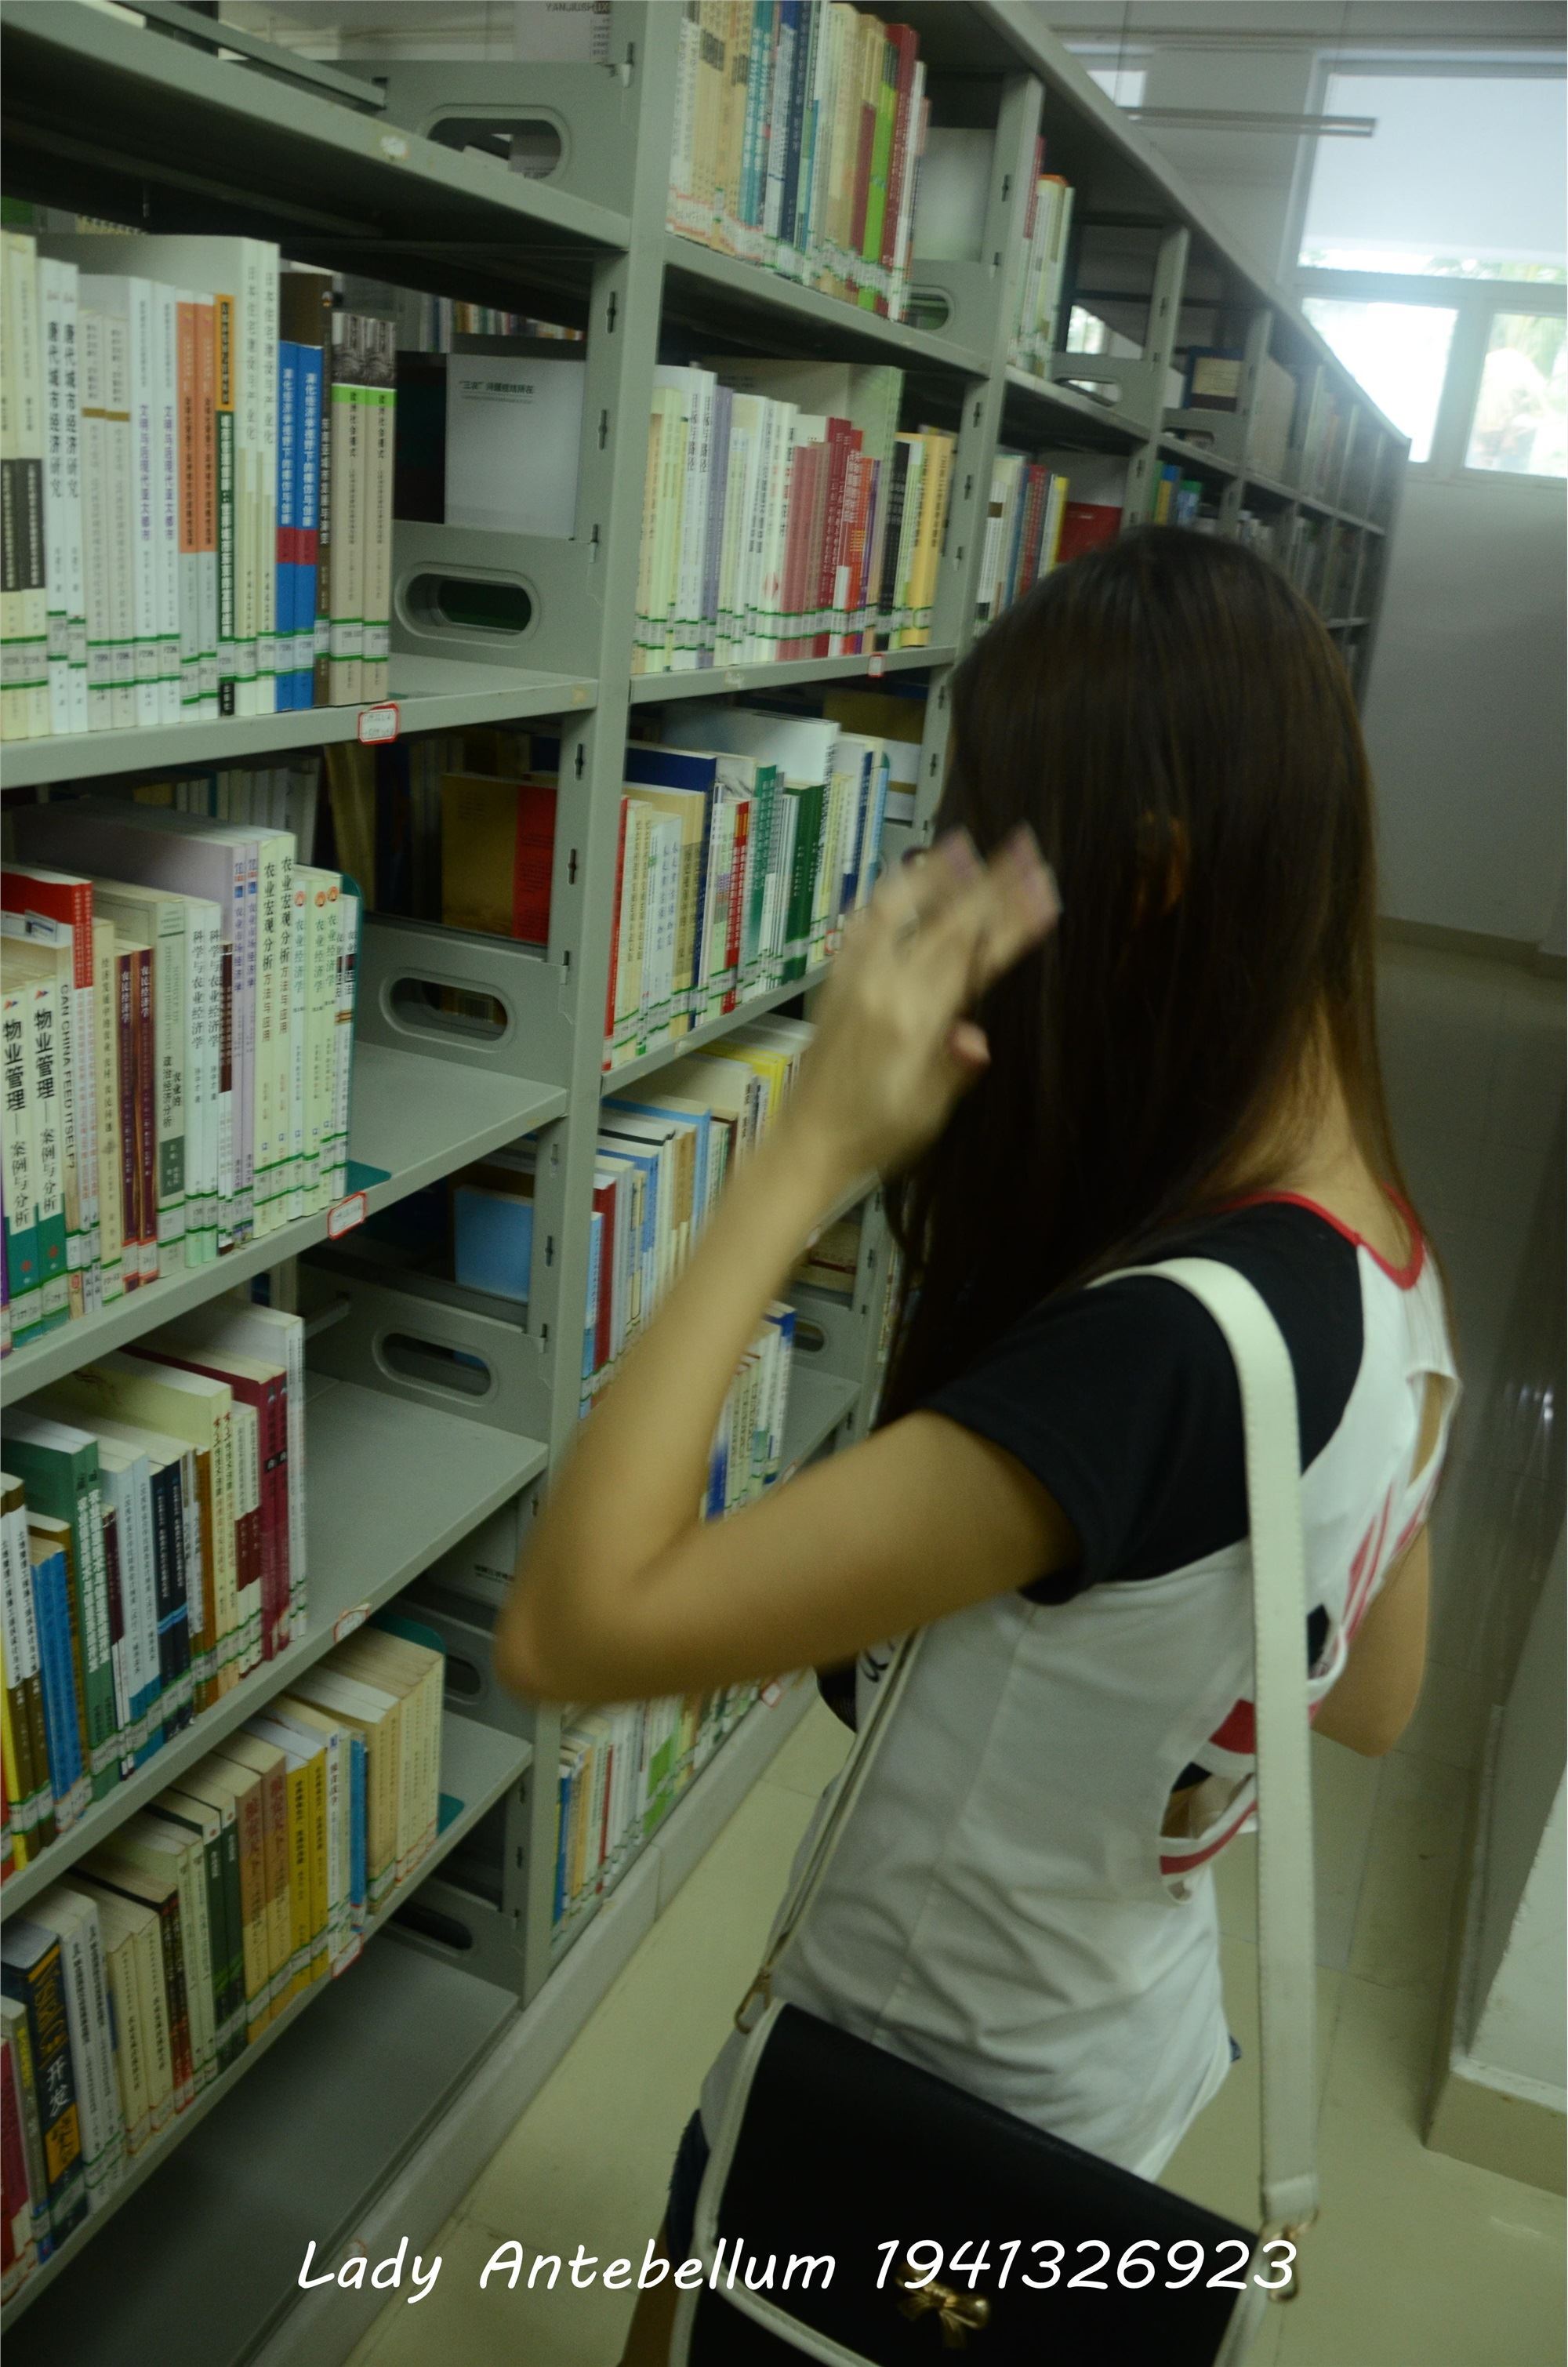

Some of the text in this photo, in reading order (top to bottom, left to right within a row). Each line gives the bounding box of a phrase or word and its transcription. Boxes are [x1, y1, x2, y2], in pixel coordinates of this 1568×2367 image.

[191, 929, 204, 1050] 科学与农业经济学
[208, 928, 220, 1049] 科学与农业经济学
[60, 984, 76, 1170] CAN CHINA FEED ITSELF?
[46, 2054, 71, 2118] 开发
